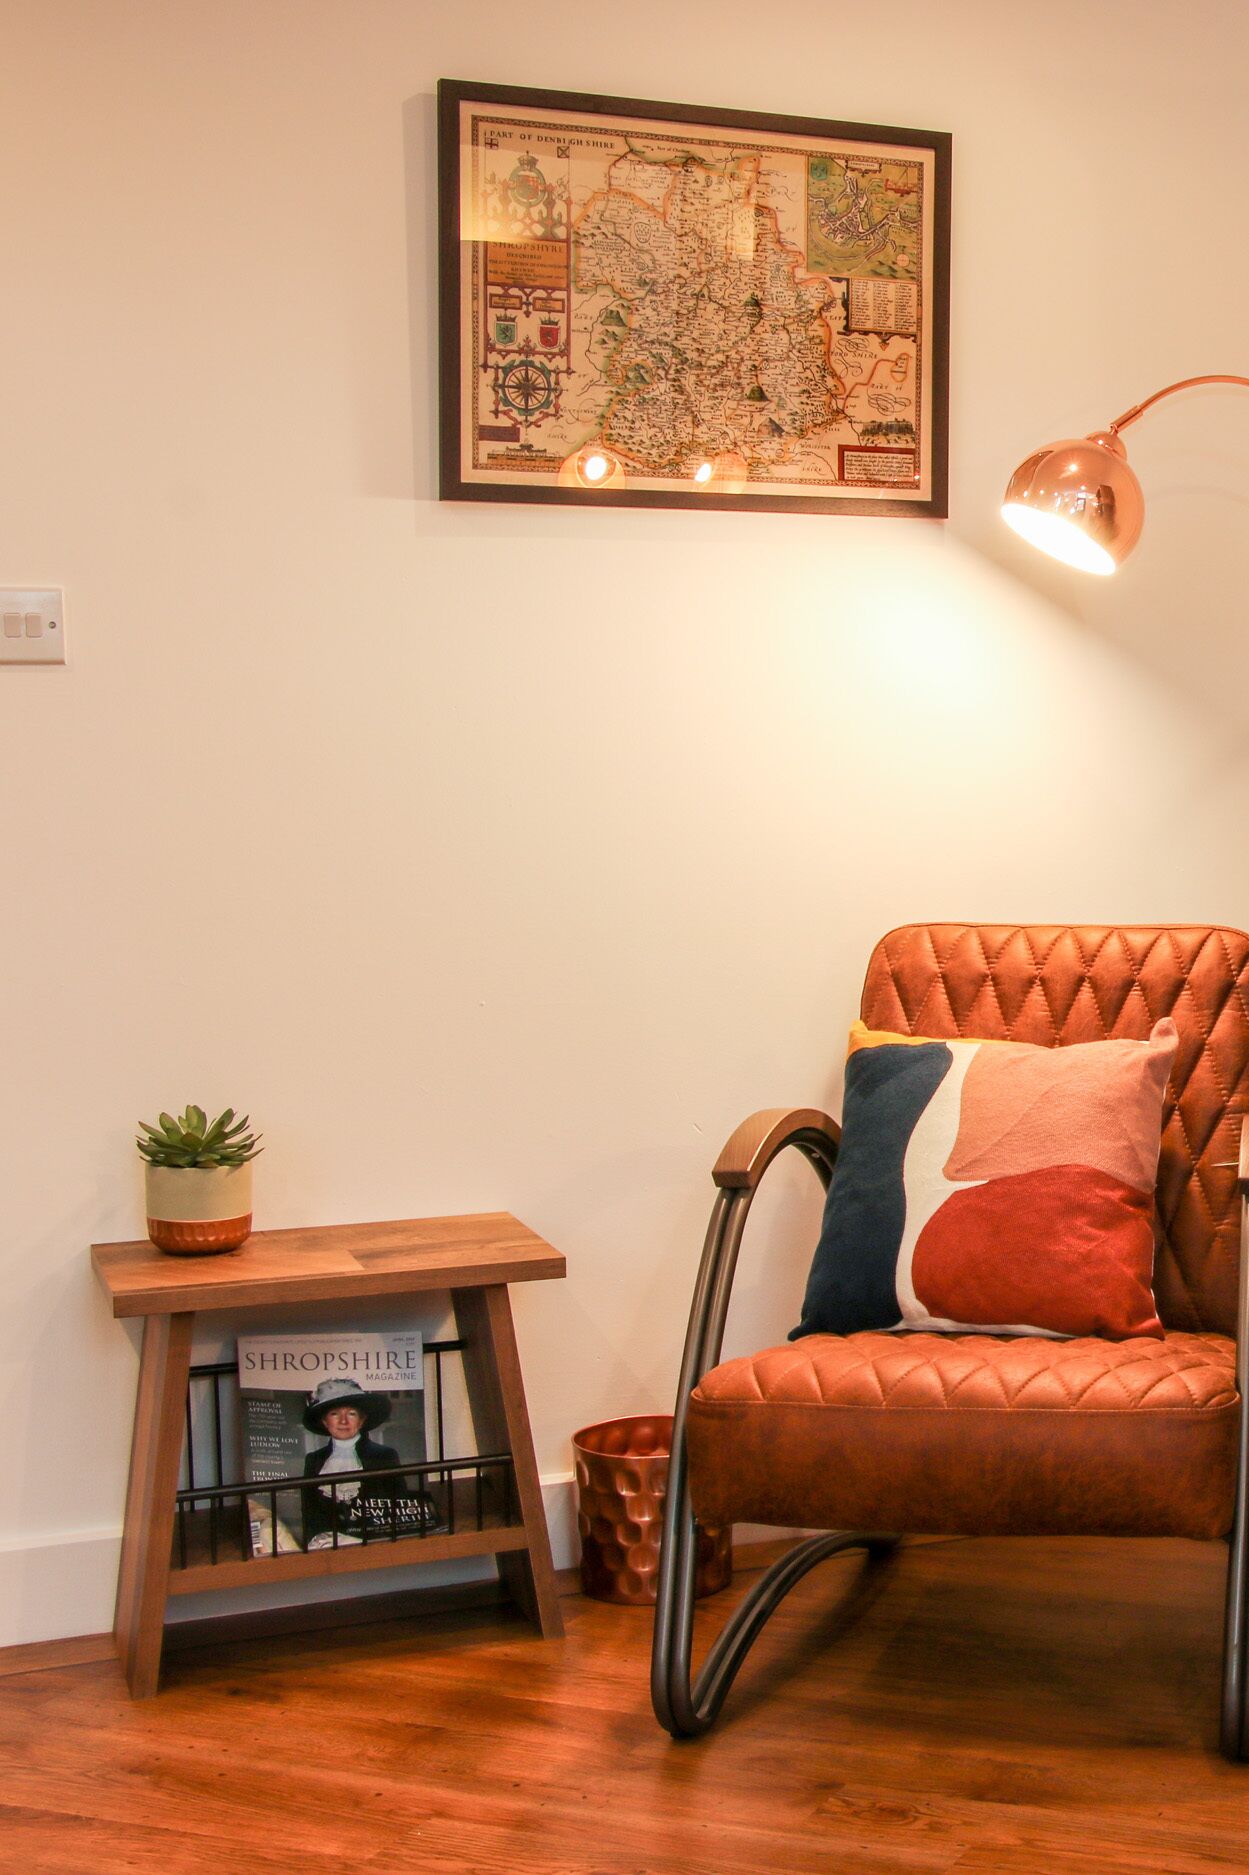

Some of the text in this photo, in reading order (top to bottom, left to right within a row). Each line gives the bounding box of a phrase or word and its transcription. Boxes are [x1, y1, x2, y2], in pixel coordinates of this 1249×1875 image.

[489, 130, 514, 139] PART
[245, 1350, 417, 1371] SHROPSHIRE
[366, 1372, 417, 1382] MAGAZINE
[356, 1498, 420, 1508] MEET TH
